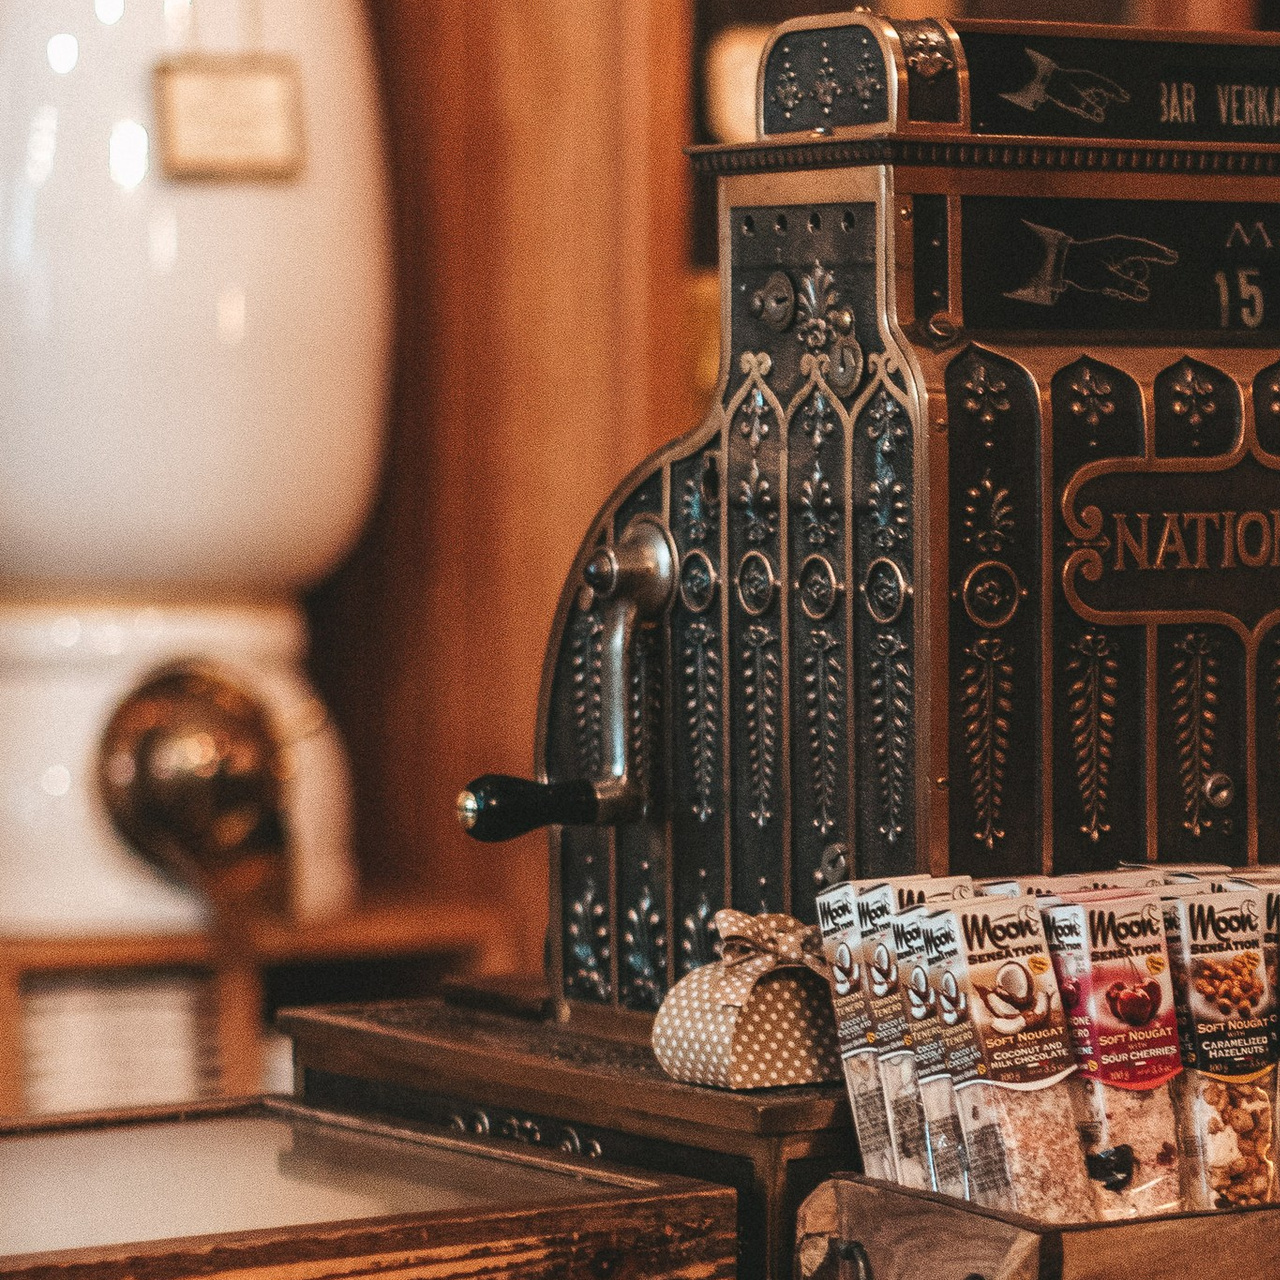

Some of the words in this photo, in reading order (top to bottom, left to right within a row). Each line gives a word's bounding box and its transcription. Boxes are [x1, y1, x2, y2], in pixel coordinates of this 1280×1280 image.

[1214, 268, 1264, 328] 15
[819, 900, 852, 927] Moon
[857, 900, 890, 928] Moon
[1189, 902, 1258, 941] Moon
[962, 914, 1039, 951] Moon
[1089, 909, 1160, 949] Moon
[922, 928, 955, 955] Moon
[1190, 939, 1260, 955] SENSATION
[967, 944, 1043, 965] SENSATION
[1091, 944, 1162, 962] SENSATION
[1099, 1033, 1127, 1046] SOFT
[1129, 1027, 1173, 1041] NOUGAT
[1197, 1023, 1225, 1035] SOFT
[1228, 1018, 1268, 1031] NOUGAT
[986, 1035, 1015, 1049] SOFT
[1017, 1026, 1064, 1041] NOUGAT
[1202, 1036, 1268, 1051] CARAMELIZED
[991, 1059, 1013, 1069] MILK
[1015, 1049, 1068, 1064] CHOCOLATE
[993, 1046, 1039, 1060] COCONUT
[1042, 1041, 1062, 1051] AND
[1101, 1053, 1129, 1065] SOUR
[1130, 1045, 1177, 1060] CHERRIES
[1208, 1045, 1264, 1059] HAZELNUTS
